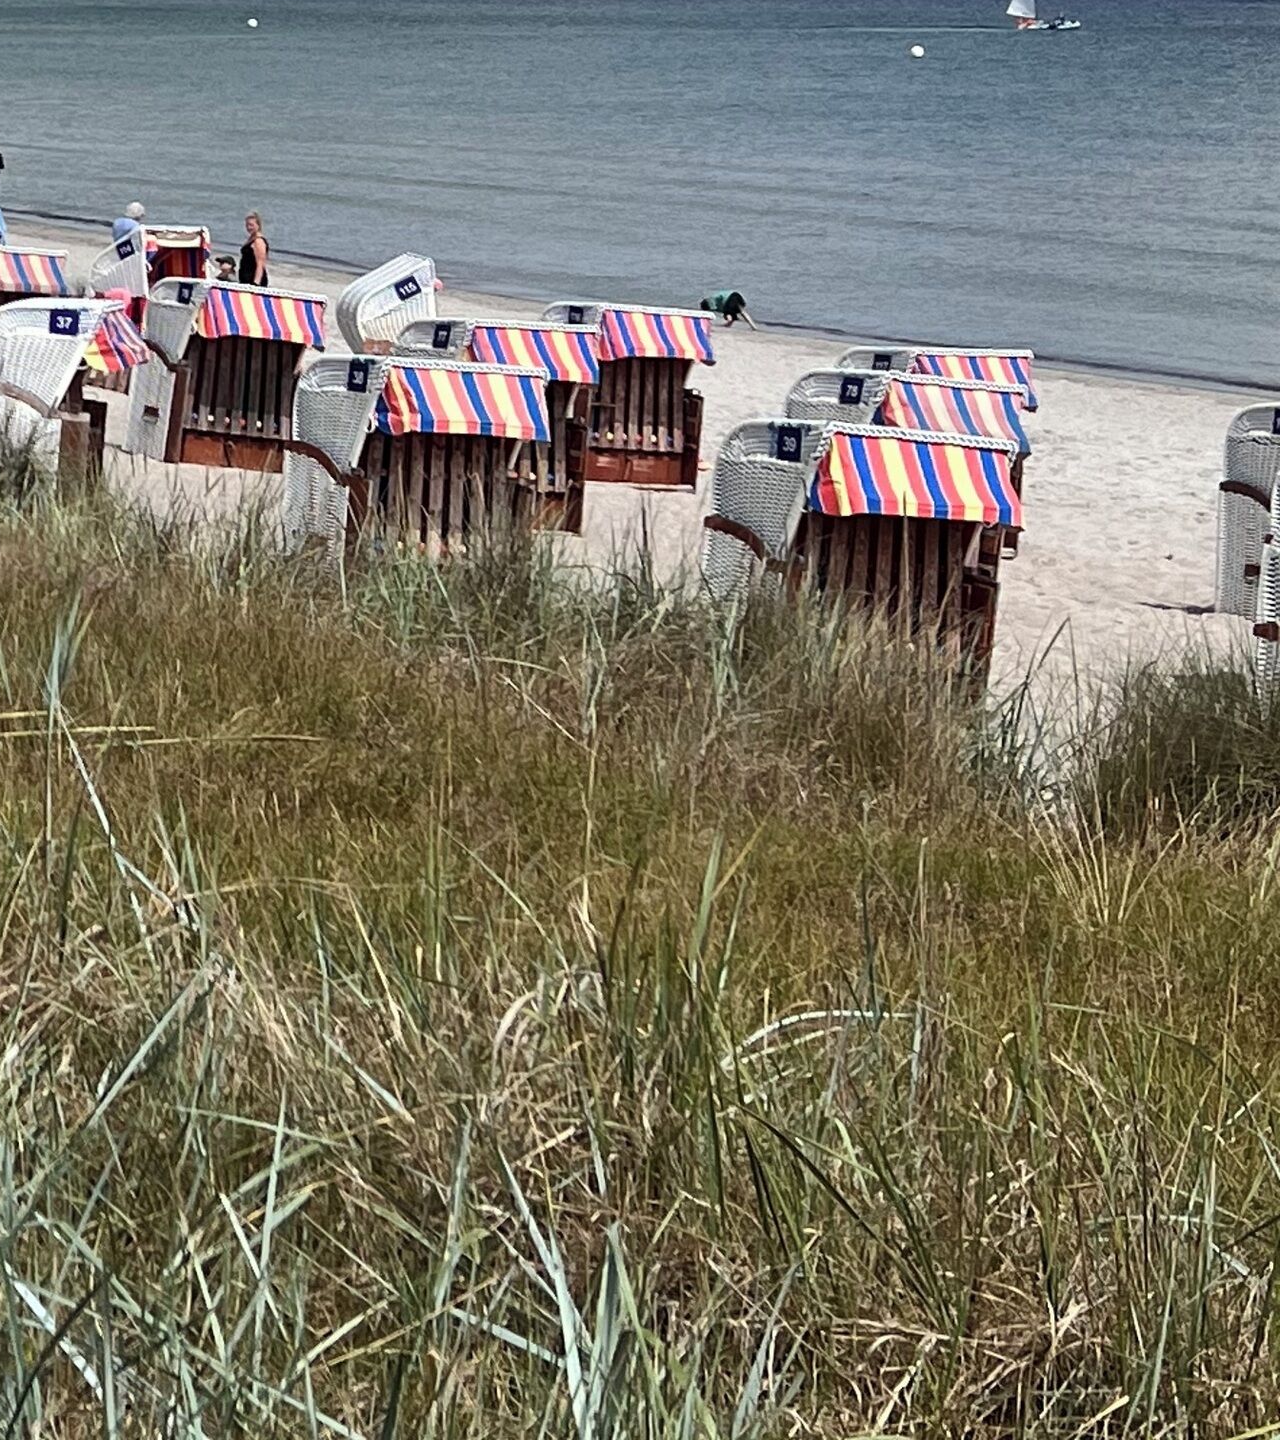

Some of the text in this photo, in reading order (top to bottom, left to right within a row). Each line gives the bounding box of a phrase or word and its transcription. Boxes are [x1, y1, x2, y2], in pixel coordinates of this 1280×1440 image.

[399, 281, 417, 296] 115
[56, 315, 73, 329] 37
[782, 435, 797, 452] 39
